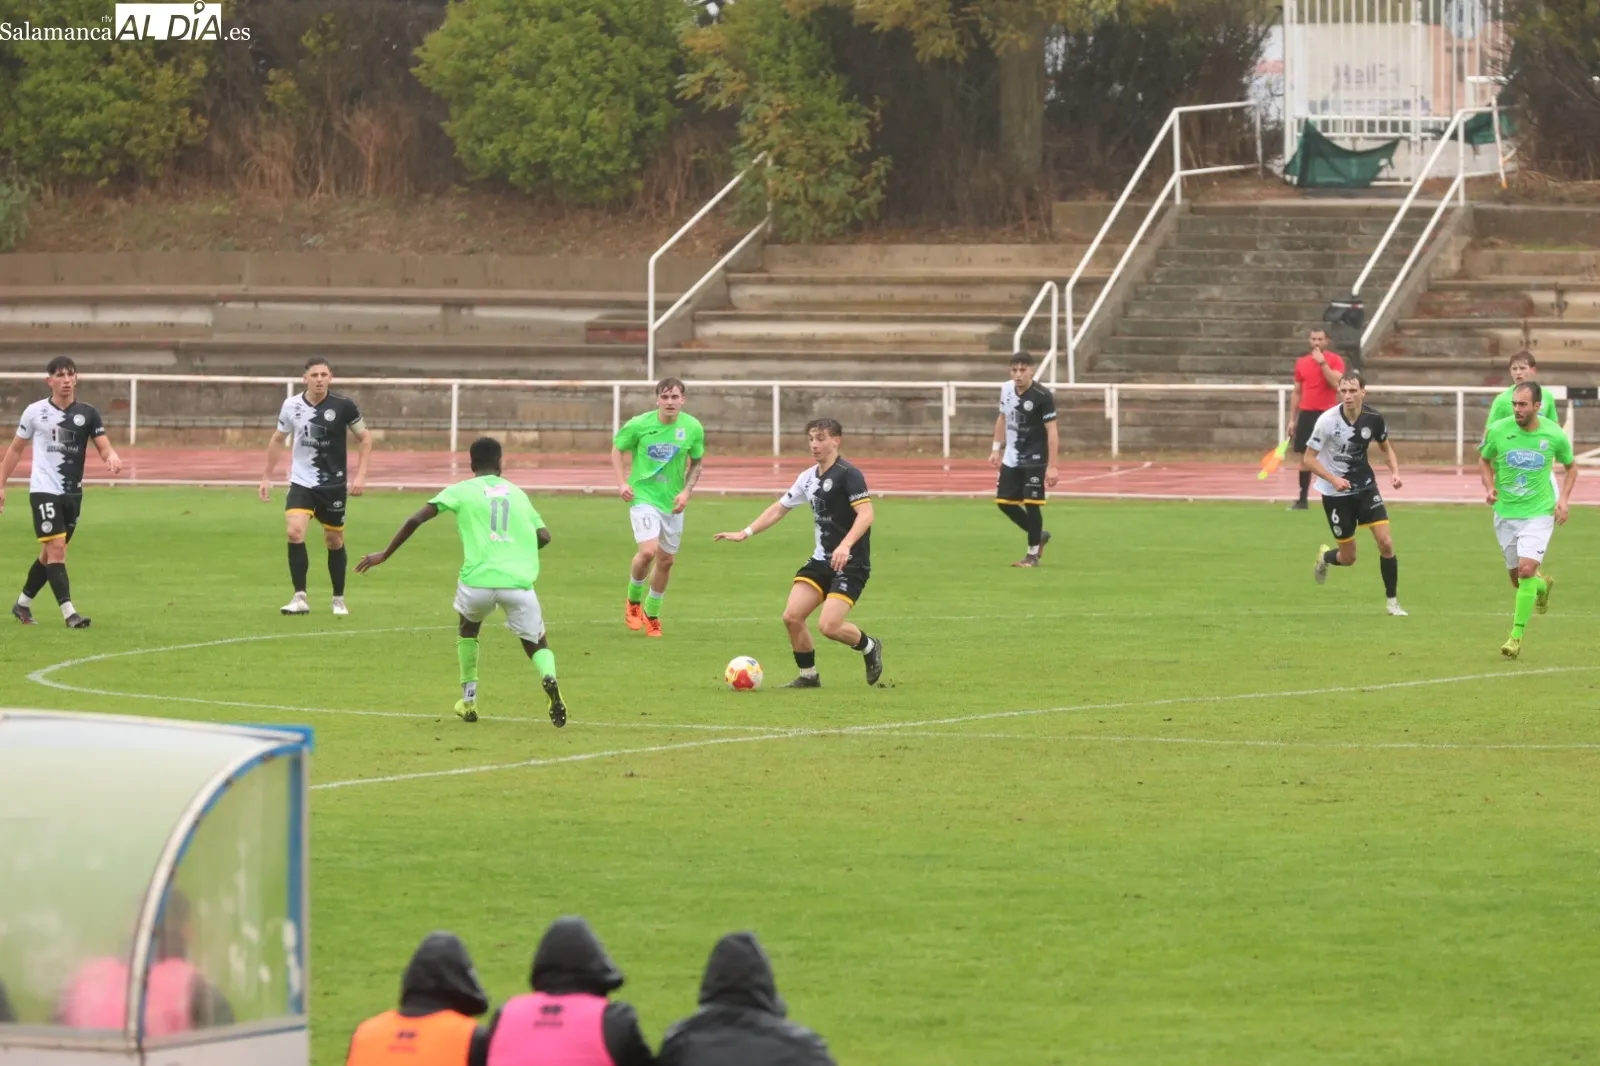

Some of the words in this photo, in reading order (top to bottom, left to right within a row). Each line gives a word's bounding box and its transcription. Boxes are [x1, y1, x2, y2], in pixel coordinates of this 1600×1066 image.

[39, 502, 56, 520] 15
[490, 498, 509, 532] 11
[1331, 508, 1340, 524] 6
